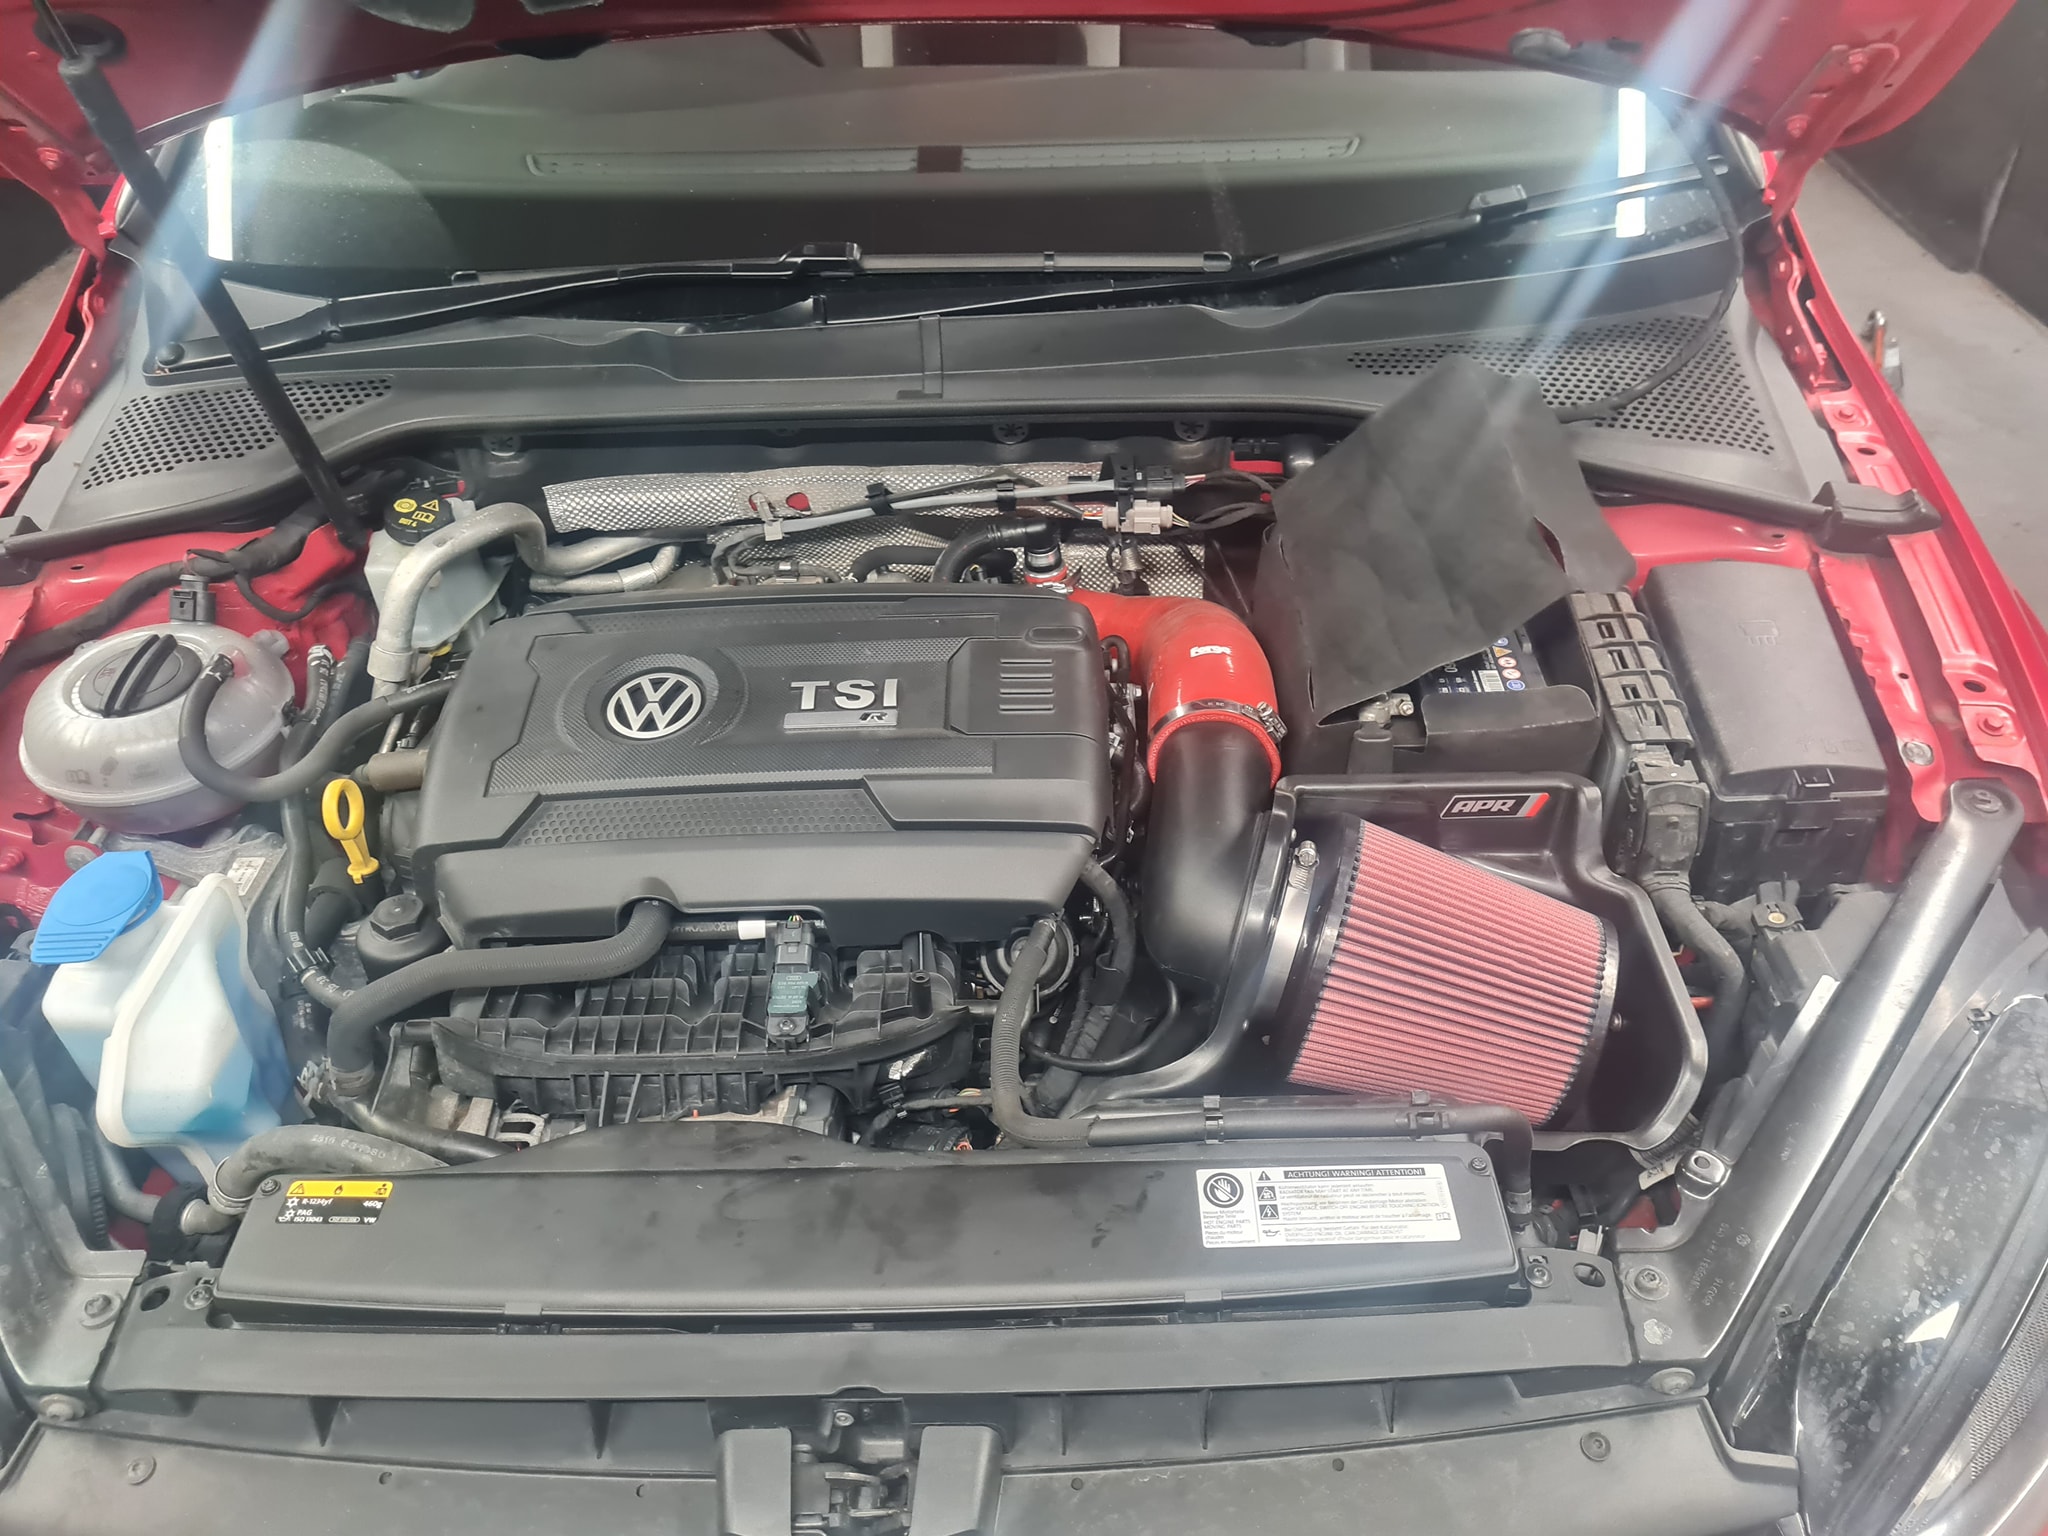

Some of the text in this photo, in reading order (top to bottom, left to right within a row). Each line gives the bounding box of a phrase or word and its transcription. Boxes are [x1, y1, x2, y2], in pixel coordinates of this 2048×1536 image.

[790, 678, 899, 710] TSI
[1450, 799, 1517, 814] APR
[1287, 1168, 1424, 1178] ACHTUNG! WARNING! ATTENTION!
[362, 1200, 383, 1209] 460g
